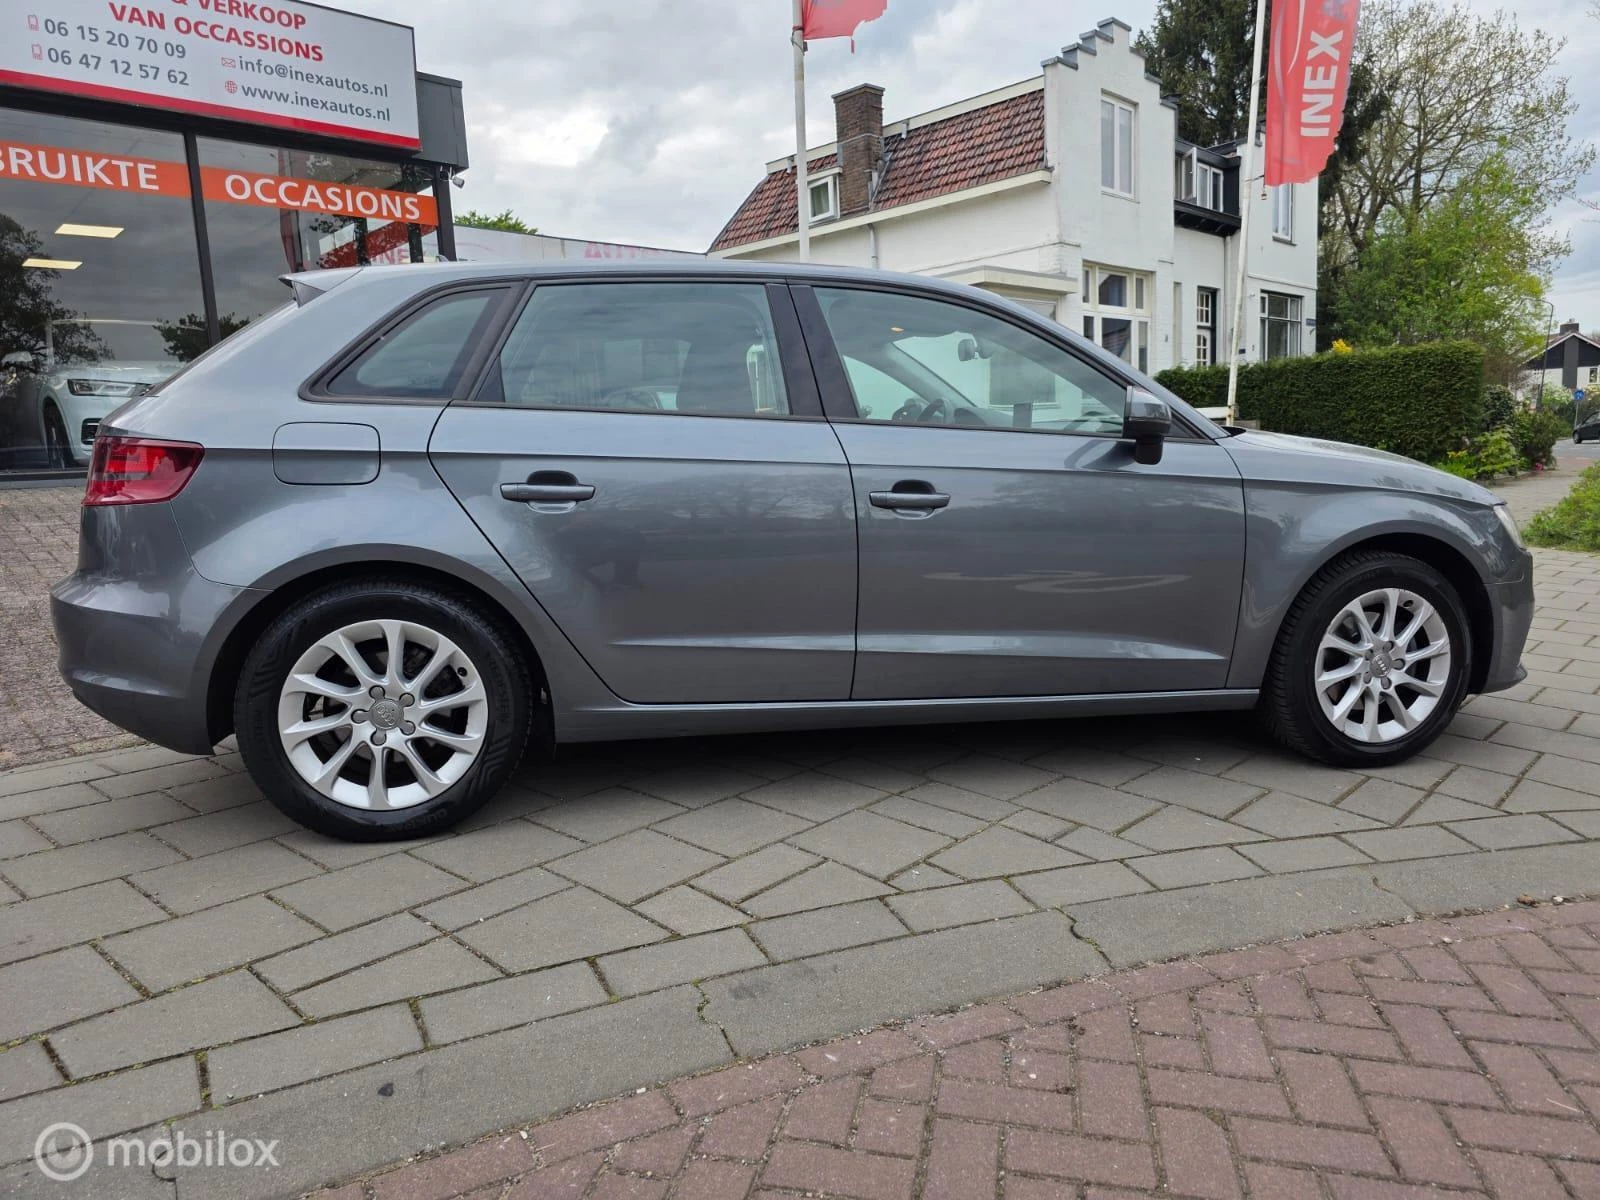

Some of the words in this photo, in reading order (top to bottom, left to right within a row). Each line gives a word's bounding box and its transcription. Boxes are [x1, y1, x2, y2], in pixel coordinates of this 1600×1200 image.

[108, 2, 165, 30] VAN
[174, 16, 324, 62] OCCASSIONS
[199, 0, 306, 29] VERKOOP
[44, 18, 69, 37] 06
[76, 25, 99, 43] 15
[105, 30, 129, 48] 20
[135, 36, 158, 53] 70
[164, 42, 187, 59] 09
[47, 47, 72, 66] 06
[78, 53, 102, 71] 47
[110, 59, 133, 77] 12
[138, 63, 160, 81] 57
[167, 69, 190, 86] 62
[239, 56, 389, 97] info@inexautos.nl
[1300, 30, 1344, 137] INEX
[241, 85, 391, 122] www.inexautos.nl
[0, 146, 159, 191] RUIKTE
[225, 174, 420, 220] OCCASIONS
